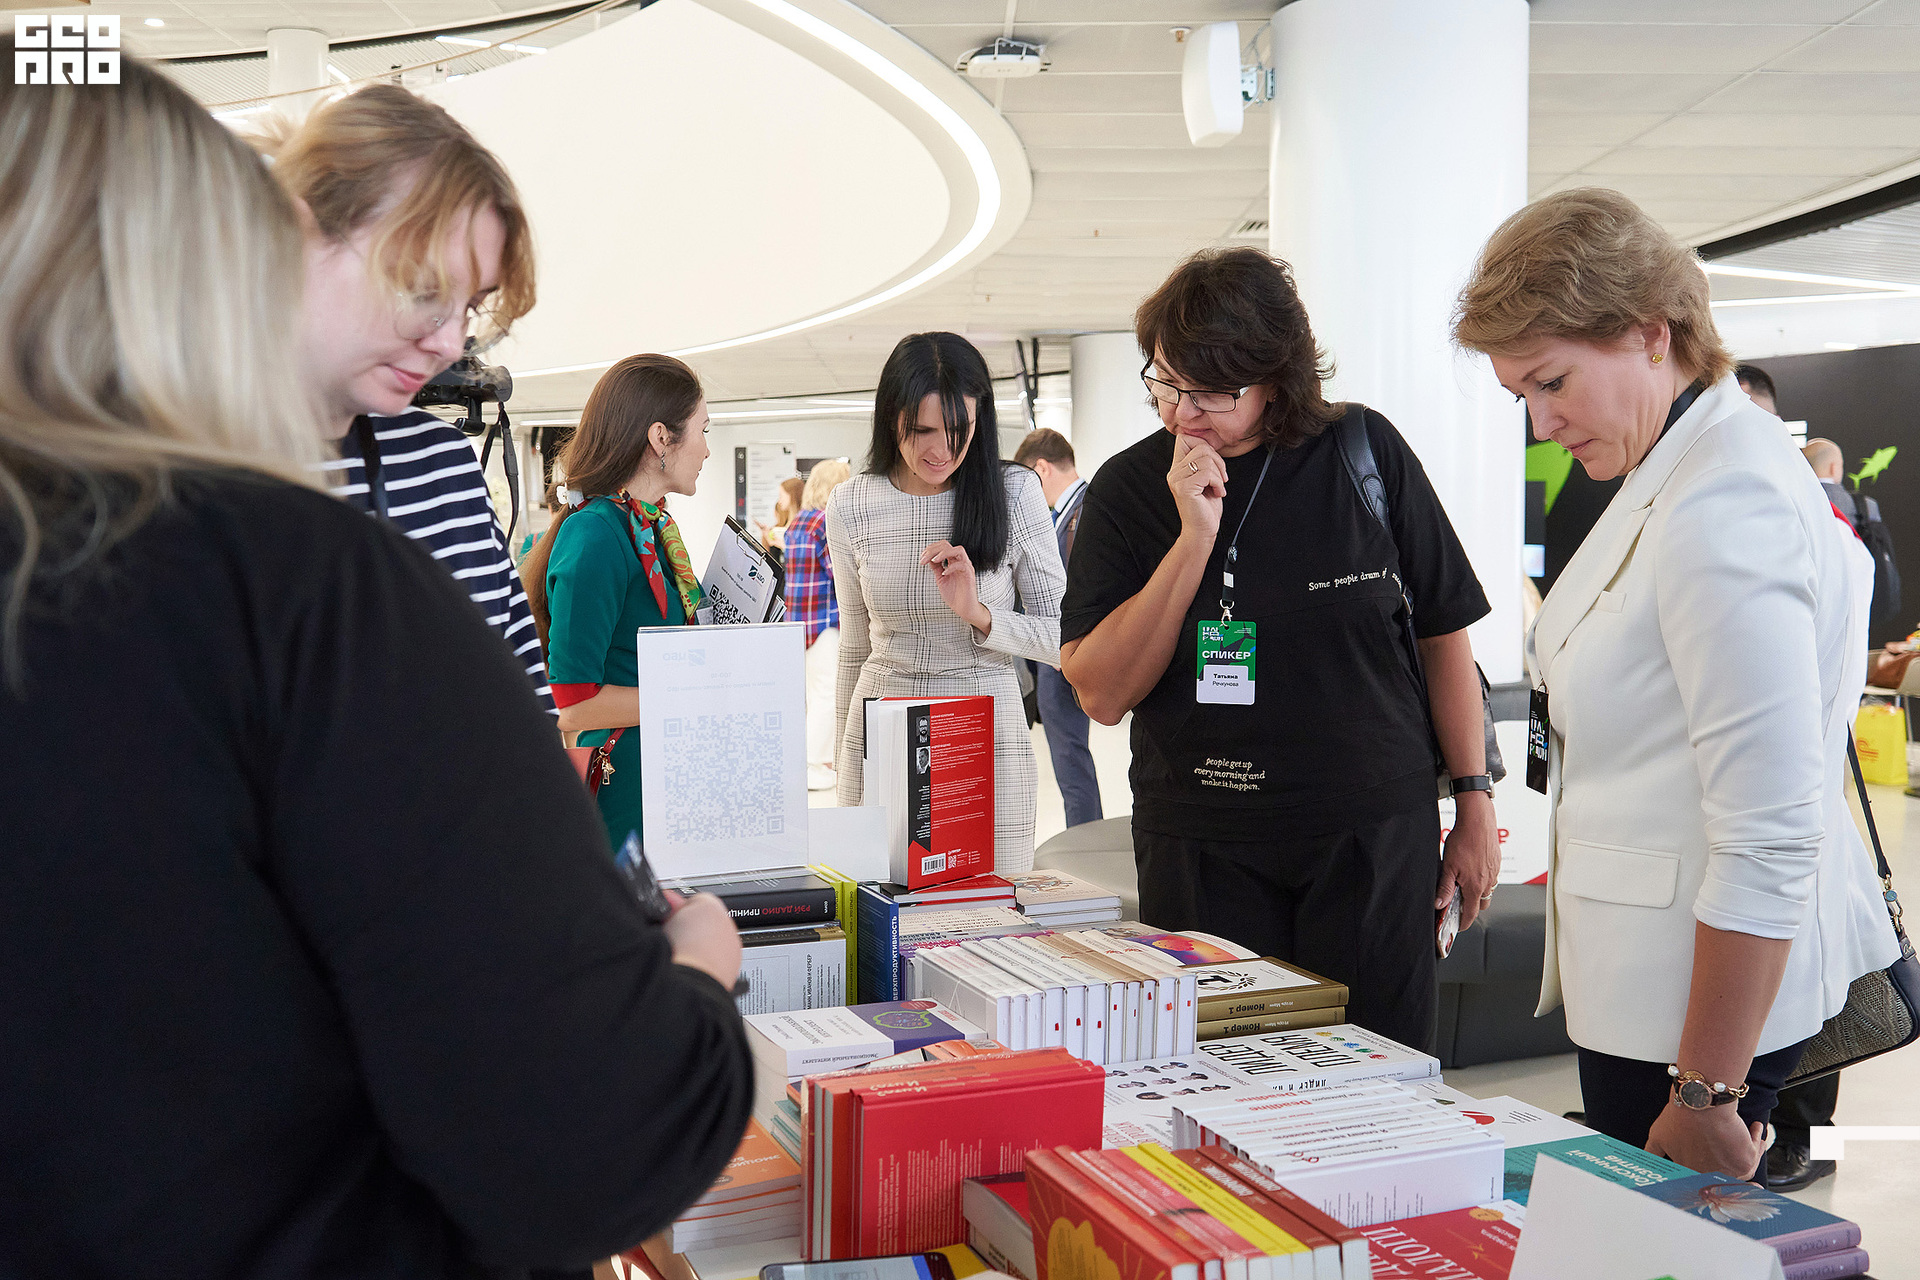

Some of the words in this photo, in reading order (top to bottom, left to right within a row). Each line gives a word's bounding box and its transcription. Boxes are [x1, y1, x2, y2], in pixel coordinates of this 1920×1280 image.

[1308, 581, 1331, 591] Some
[1334, 573, 1359, 588] people
[1202, 650, 1252, 660] СПИКЕР
[1205, 757, 1230, 768] people
[1230, 760, 1242, 770] get
[1242, 761, 1253, 771] up
[1193, 767, 1214, 778] every
[1214, 769, 1249, 782] morning
[1248, 770, 1266, 780] and
[1201, 778, 1222, 787] make
[1228, 780, 1261, 791] happen.
[726, 908, 761, 918] ПРИНЦИ
[762, 904, 793, 915] ДАЛИО
[793, 904, 811, 913] РЭЙ
[891, 915, 899, 1001] ВЕРХПРОДУКТИВНОСТЬ
[1228, 1006, 1235, 1014] 1
[1236, 1002, 1265, 1013] Номер
[1223, 1025, 1230, 1034] 1
[1231, 1022, 1261, 1033] Номер
[1259, 1034, 1362, 1068] ПЛЕМЯ
[802, 1057, 832, 1065] интеллект
[1198, 1043, 1298, 1076] ЛИДЕР
[1235, 1092, 1297, 1103] Deadline
[1249, 1099, 1312, 1112] Deadline
[1780, 1238, 1828, 1259] ТОКСИЧН
